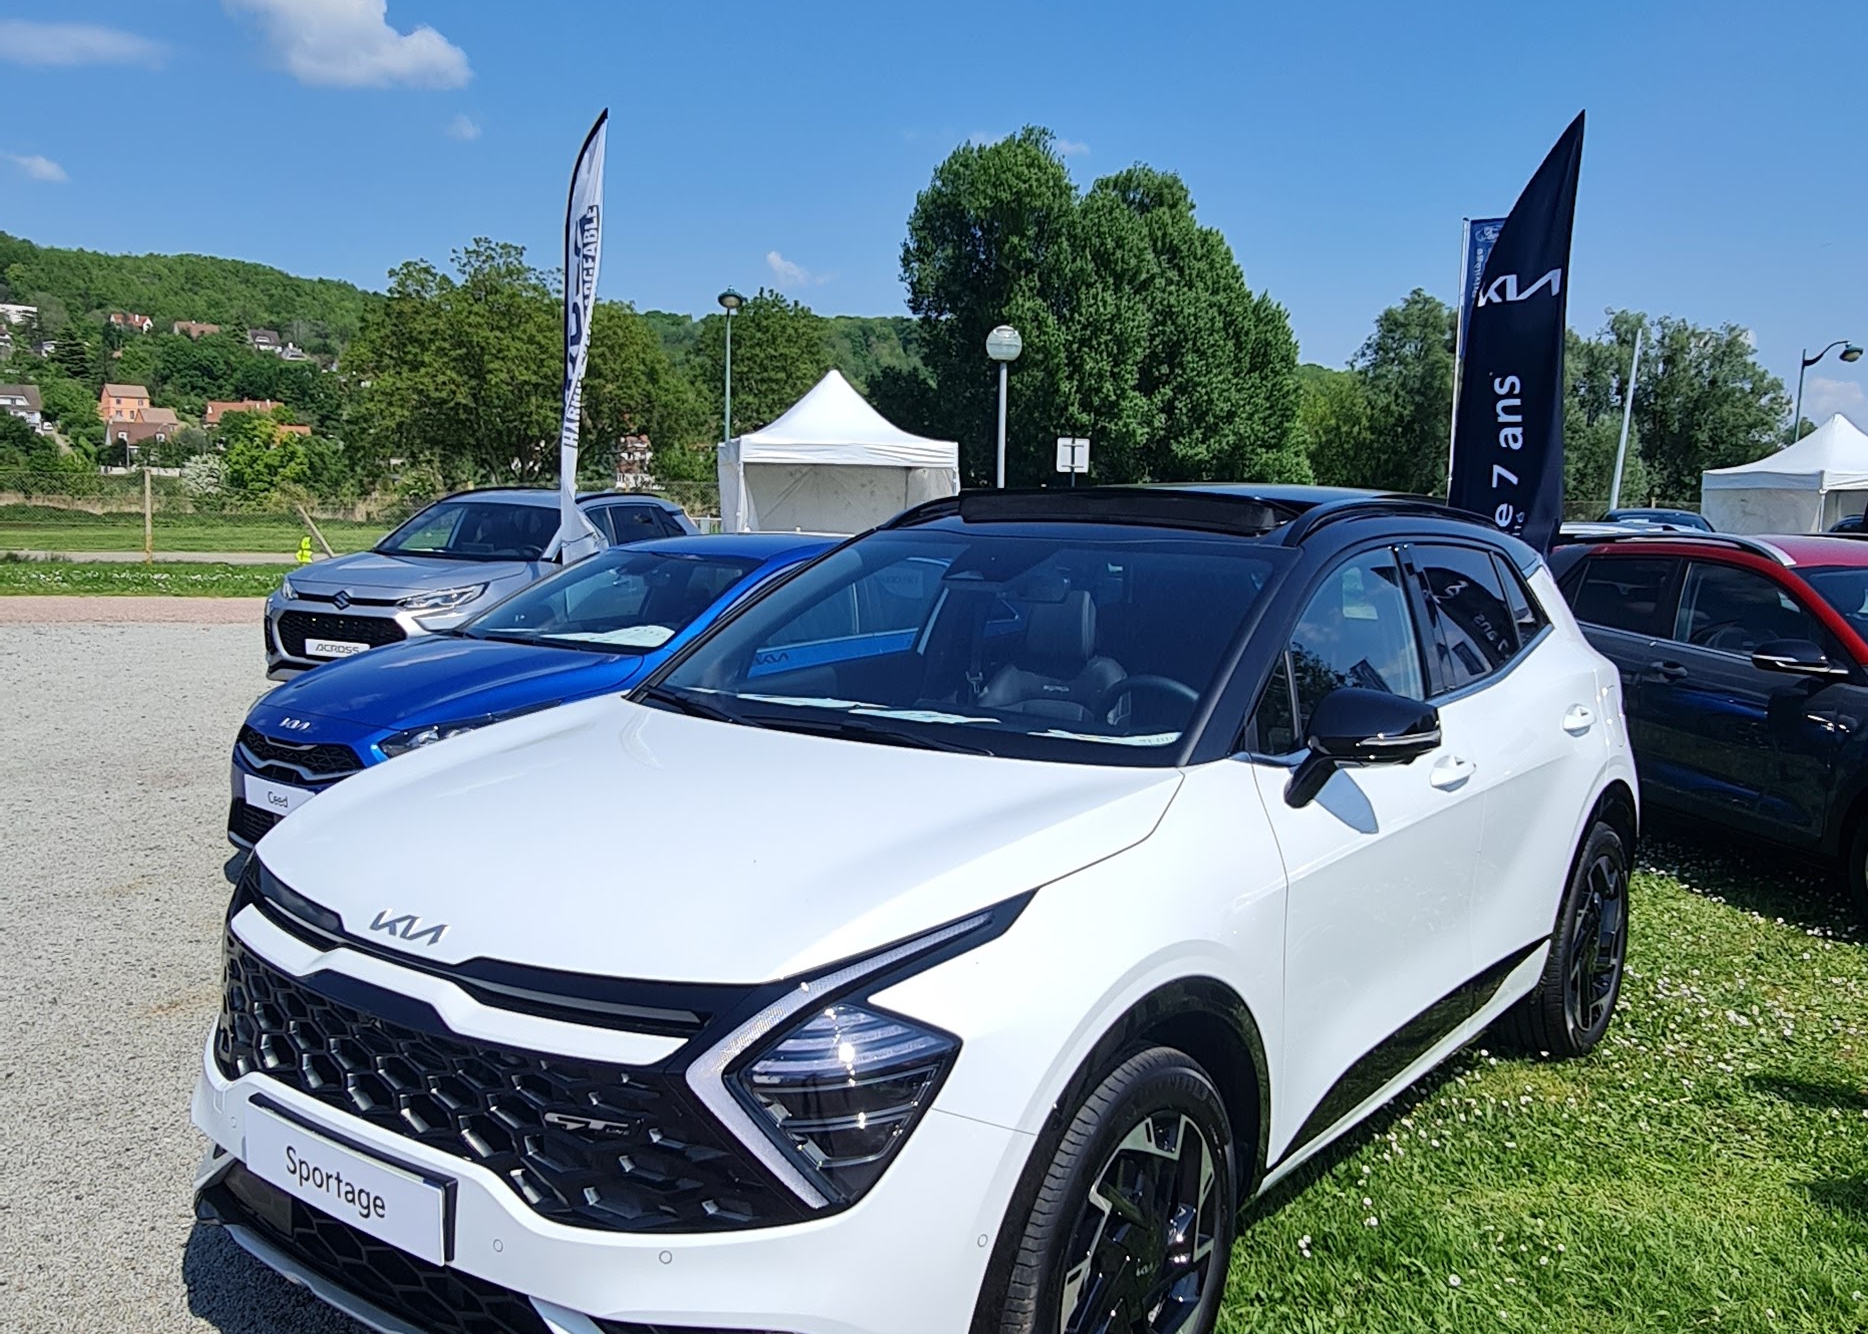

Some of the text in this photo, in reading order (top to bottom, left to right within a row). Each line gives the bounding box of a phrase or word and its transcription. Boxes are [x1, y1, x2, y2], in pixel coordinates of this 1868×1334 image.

[1493, 375, 1524, 450] ans
[1491, 464, 1519, 488] 7
[315, 643, 360, 654] ACROSS
[267, 791, 289, 808] Ceed
[369, 908, 450, 947] KIA
[286, 1145, 386, 1219] Sportage
